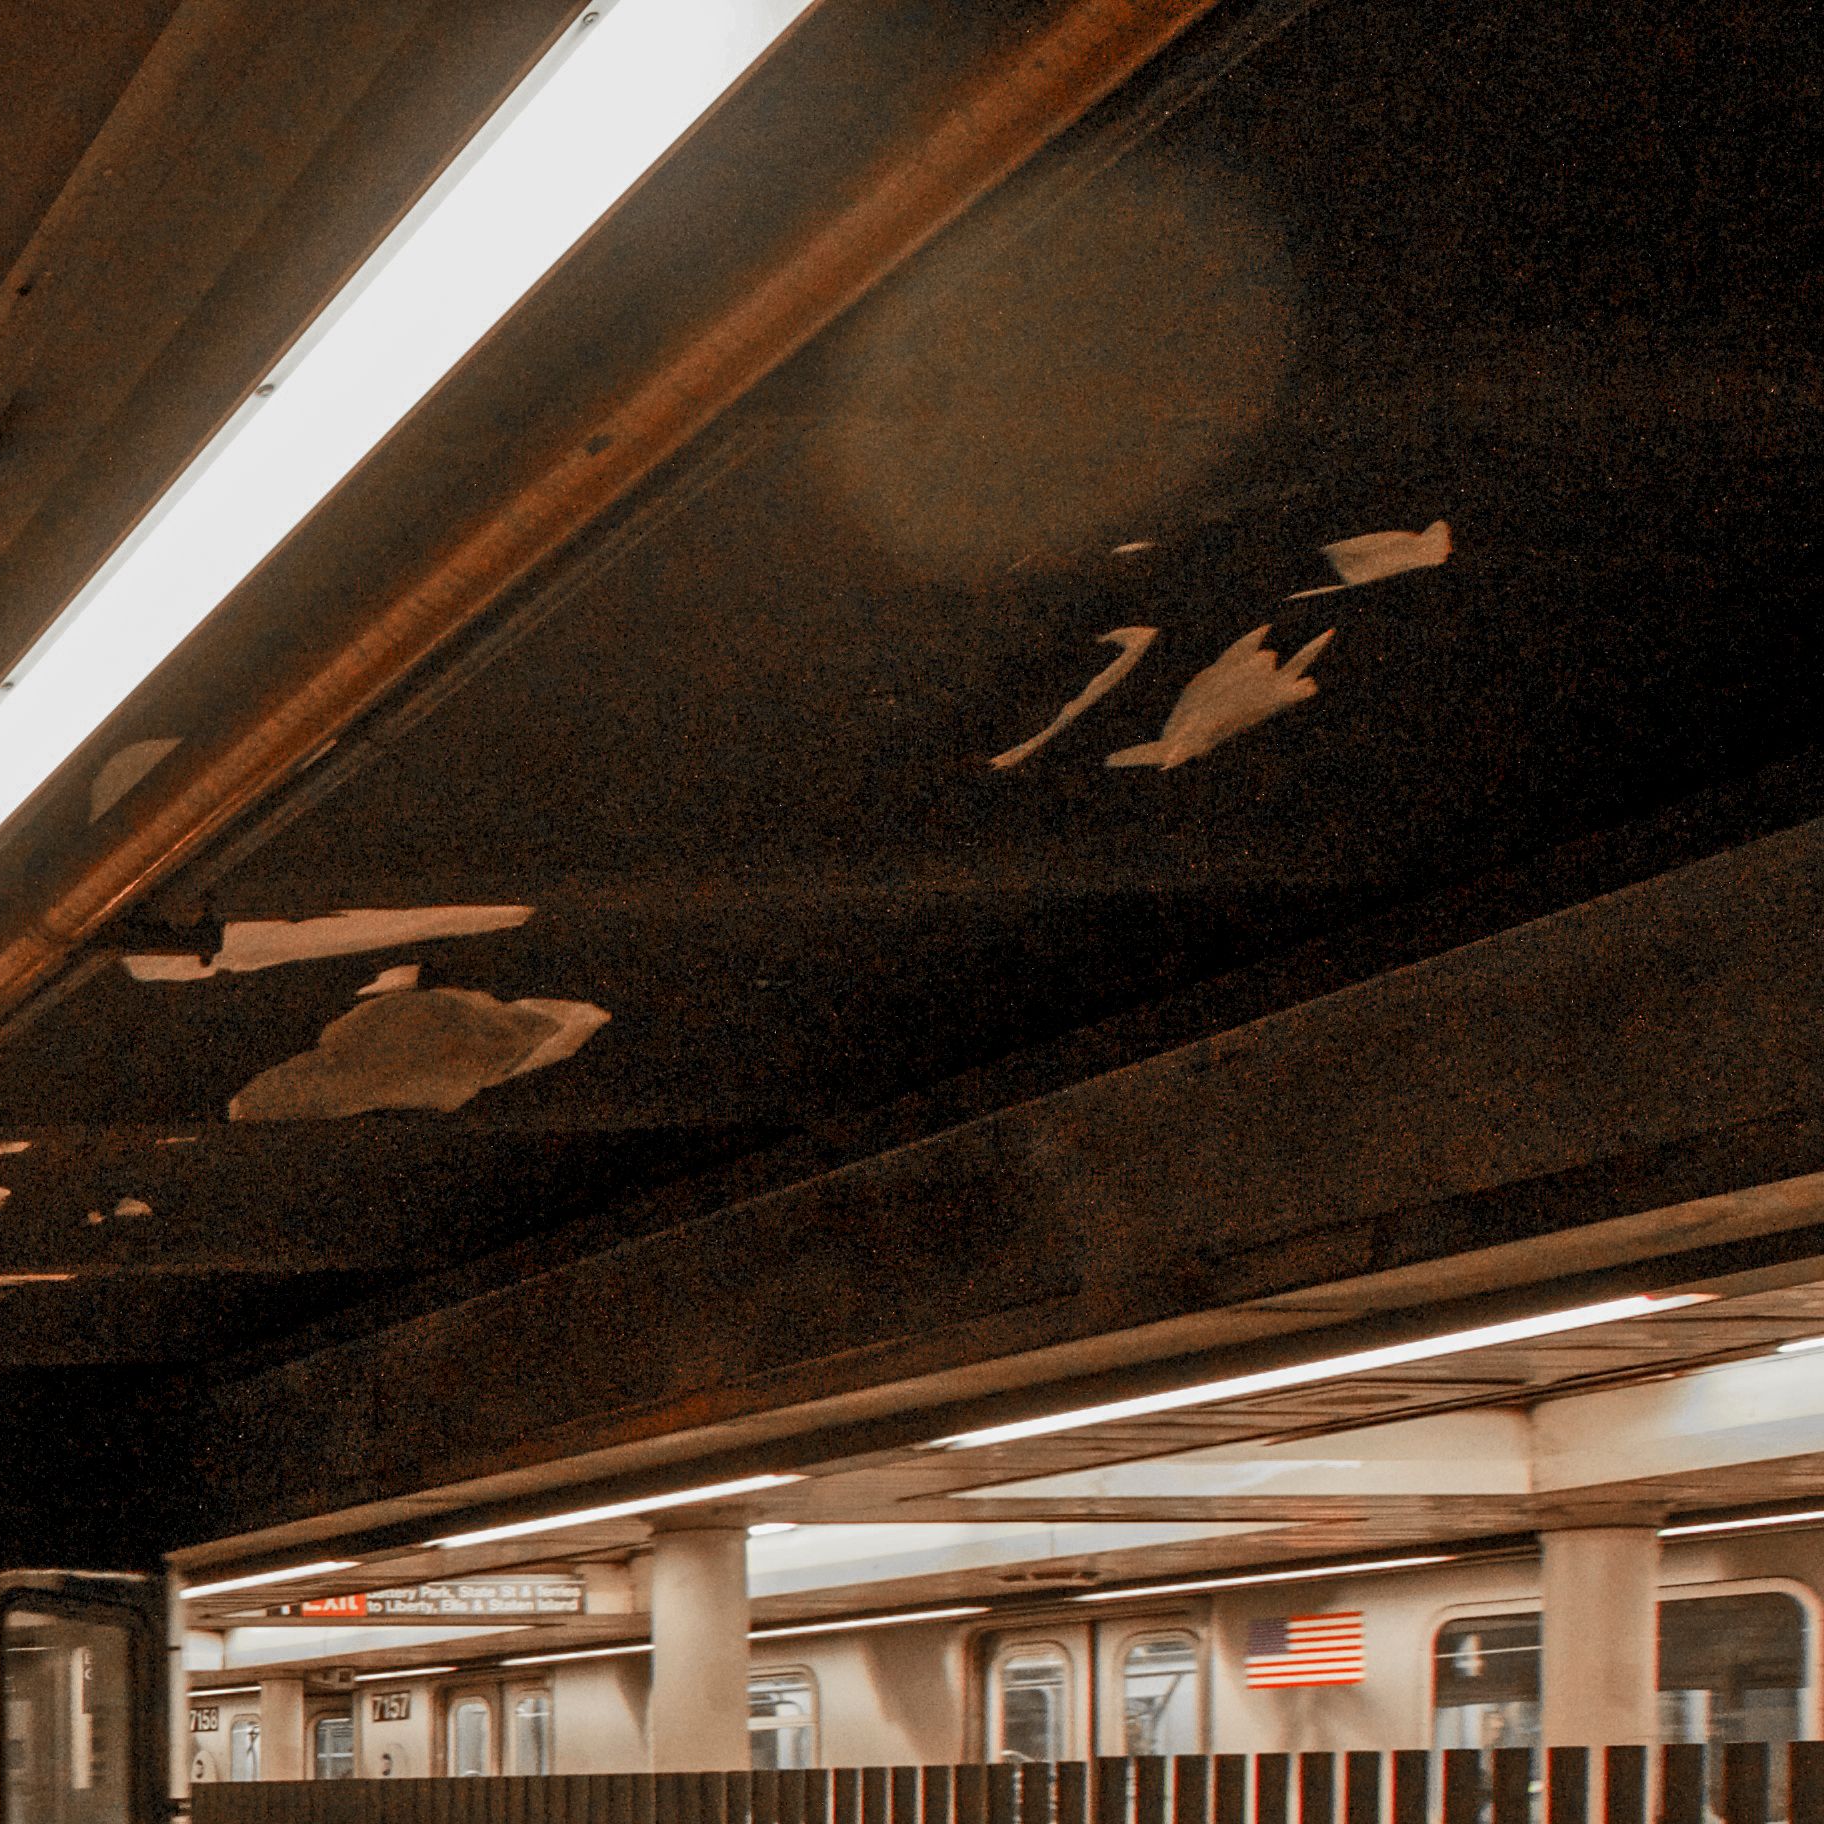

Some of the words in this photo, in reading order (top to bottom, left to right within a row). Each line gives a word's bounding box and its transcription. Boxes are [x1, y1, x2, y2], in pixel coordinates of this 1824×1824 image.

[366, 1601, 383, 1613] to
[374, 1692, 410, 1722] 7157
[189, 1709, 218, 1732] 7158
